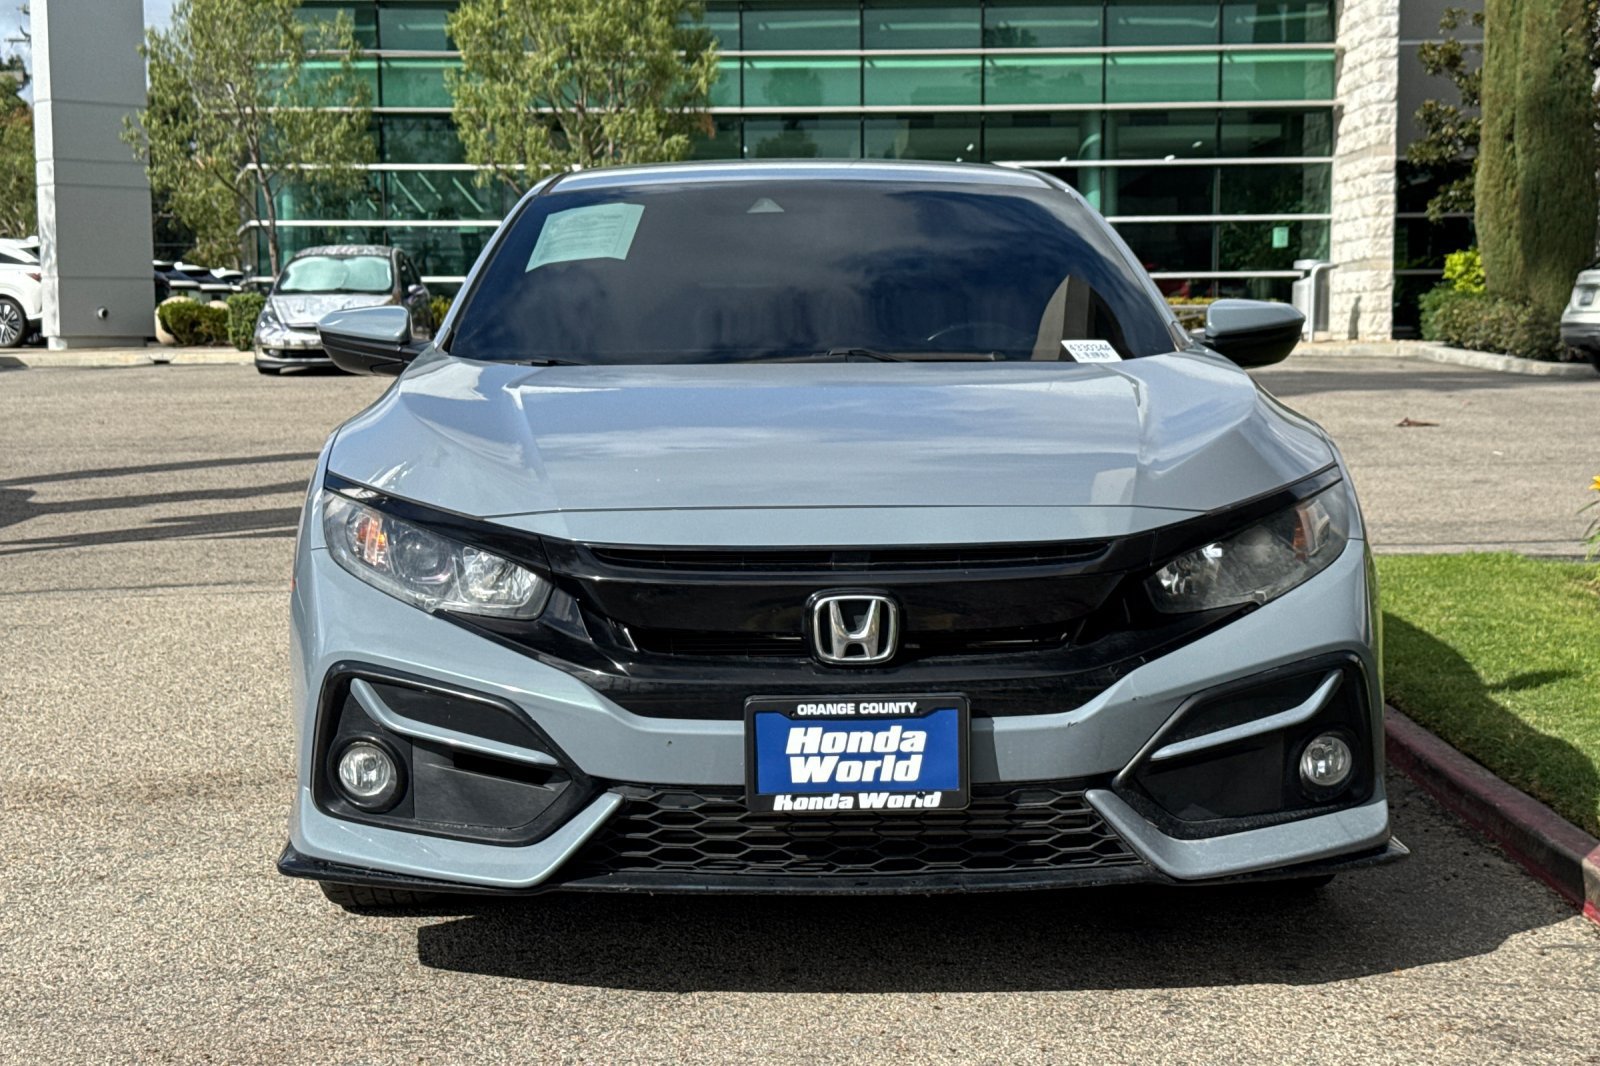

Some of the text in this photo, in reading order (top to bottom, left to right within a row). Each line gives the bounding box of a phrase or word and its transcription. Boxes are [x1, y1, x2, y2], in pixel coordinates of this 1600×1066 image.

[797, 702, 917, 715] ORANGE COUNTY
[786, 725, 927, 754] Honda
[790, 754, 923, 783] World
[773, 791, 942, 811] Honda World
